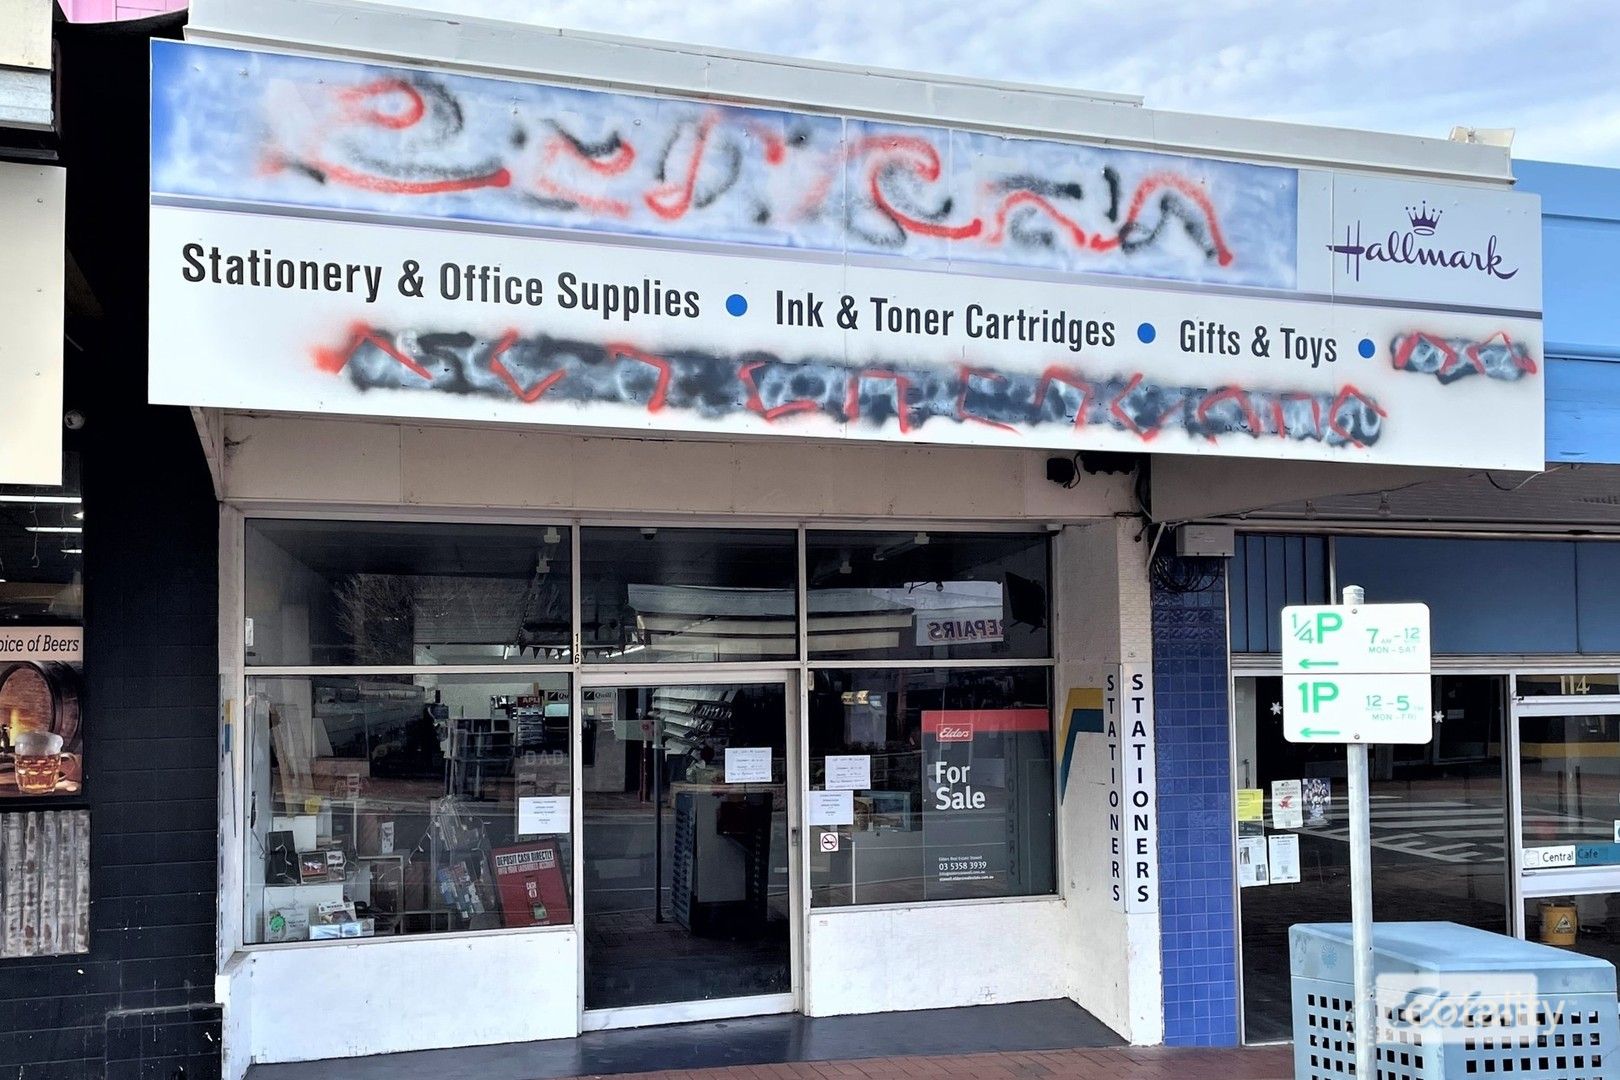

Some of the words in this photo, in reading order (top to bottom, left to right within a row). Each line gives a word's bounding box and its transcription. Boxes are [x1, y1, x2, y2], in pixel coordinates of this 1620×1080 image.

[1325, 220, 1519, 281] Hallmark
[183, 244, 381, 302] Stationery
[398, 259, 424, 297] &
[440, 262, 543, 306] Office
[557, 272, 700, 321] Supplies
[776, 290, 824, 328] Ink
[836, 295, 859, 330] &
[870, 297, 954, 336] Toner
[966, 304, 1115, 352] Cartridges
[1180, 319, 1241, 356] Gifts
[1251, 325, 1270, 358] &
[1280, 327, 1337, 368] Toys
[27, 634, 41, 652] of
[42, 634, 80, 652] Beers
[1298, 682, 1339, 713] 1P
[1560, 675, 1590, 695] 114
[939, 727, 969, 739] Elders
[935, 761, 971, 784] For
[936, 785, 986, 811] Sale
[1107, 674, 1120, 902] STATIONERS
[1132, 673, 1149, 902] STATIONERS
[496, 854, 518, 867] DEPOSIT
[938, 862, 949, 871] 03
[950, 861, 968, 870] 5358
[970, 861, 987, 870] 3939
[1542, 851, 1574, 863] Central
[1578, 848, 1598, 859] Cafe
